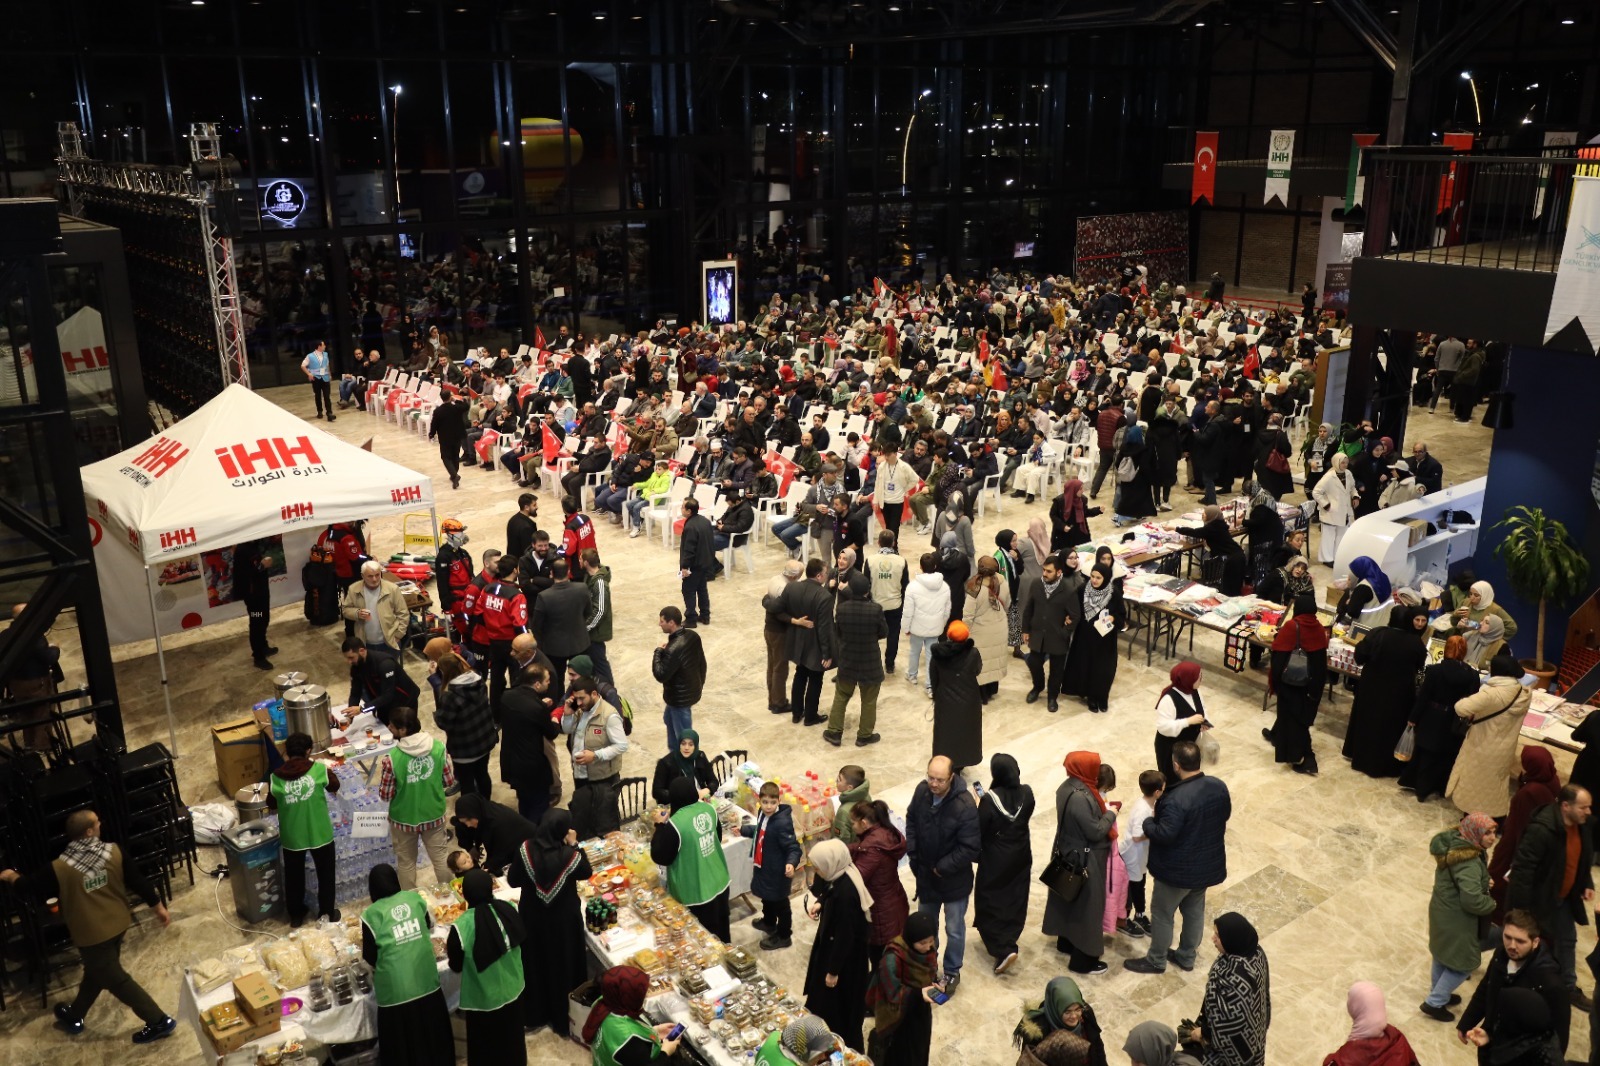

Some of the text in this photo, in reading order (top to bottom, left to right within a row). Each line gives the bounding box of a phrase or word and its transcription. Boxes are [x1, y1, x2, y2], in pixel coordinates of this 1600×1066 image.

[131, 436, 190, 479] iHH
[214, 435, 322, 479] iHH
[231, 465, 327, 488] إدارة الكوارث
[390, 485, 421, 503] iHH
[280, 501, 314, 521] iHH
[159, 526, 197, 549] iHH
[391, 917, 421, 940] iHH
